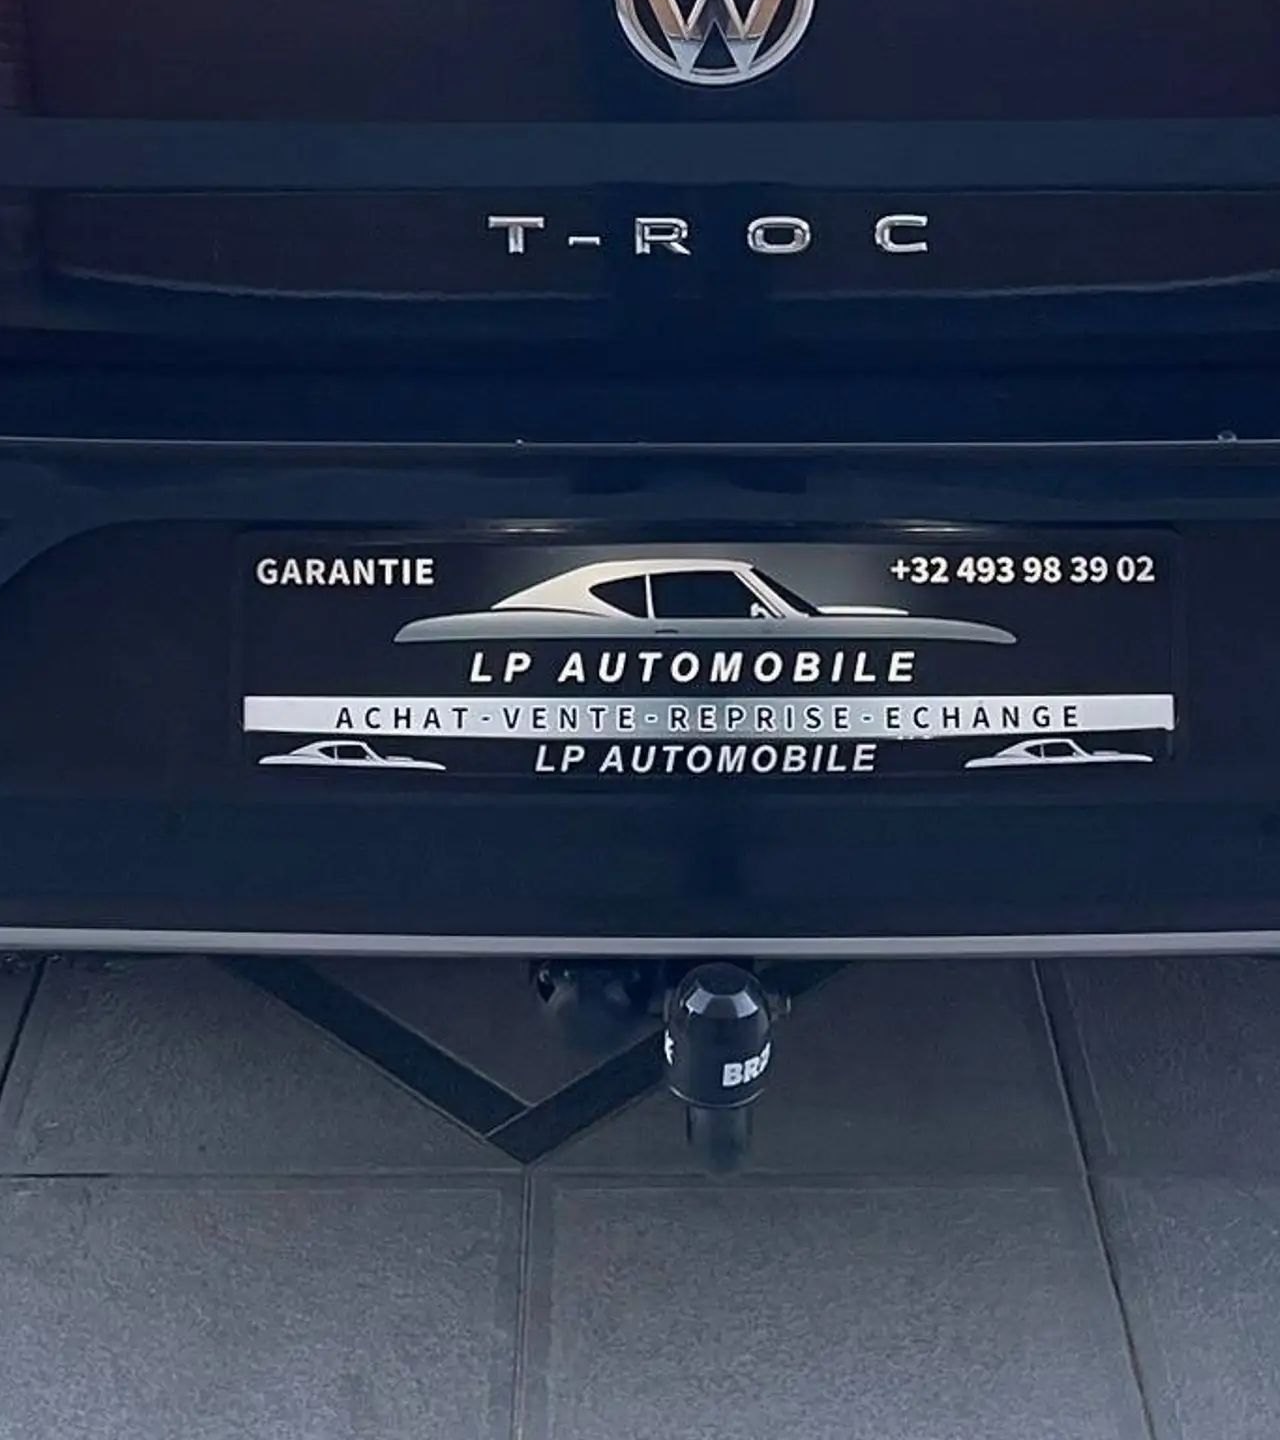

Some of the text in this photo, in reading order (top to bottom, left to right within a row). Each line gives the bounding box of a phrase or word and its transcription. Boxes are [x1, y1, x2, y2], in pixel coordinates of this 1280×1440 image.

[487, 214, 929, 256] T-ROC
[256, 558, 435, 586] GARANTIE
[890, 555, 1155, 584] +32 493 98 39 02
[469, 651, 916, 683] LP AUTOMOBILE
[534, 744, 878, 773] LP AUTOMOBILE
